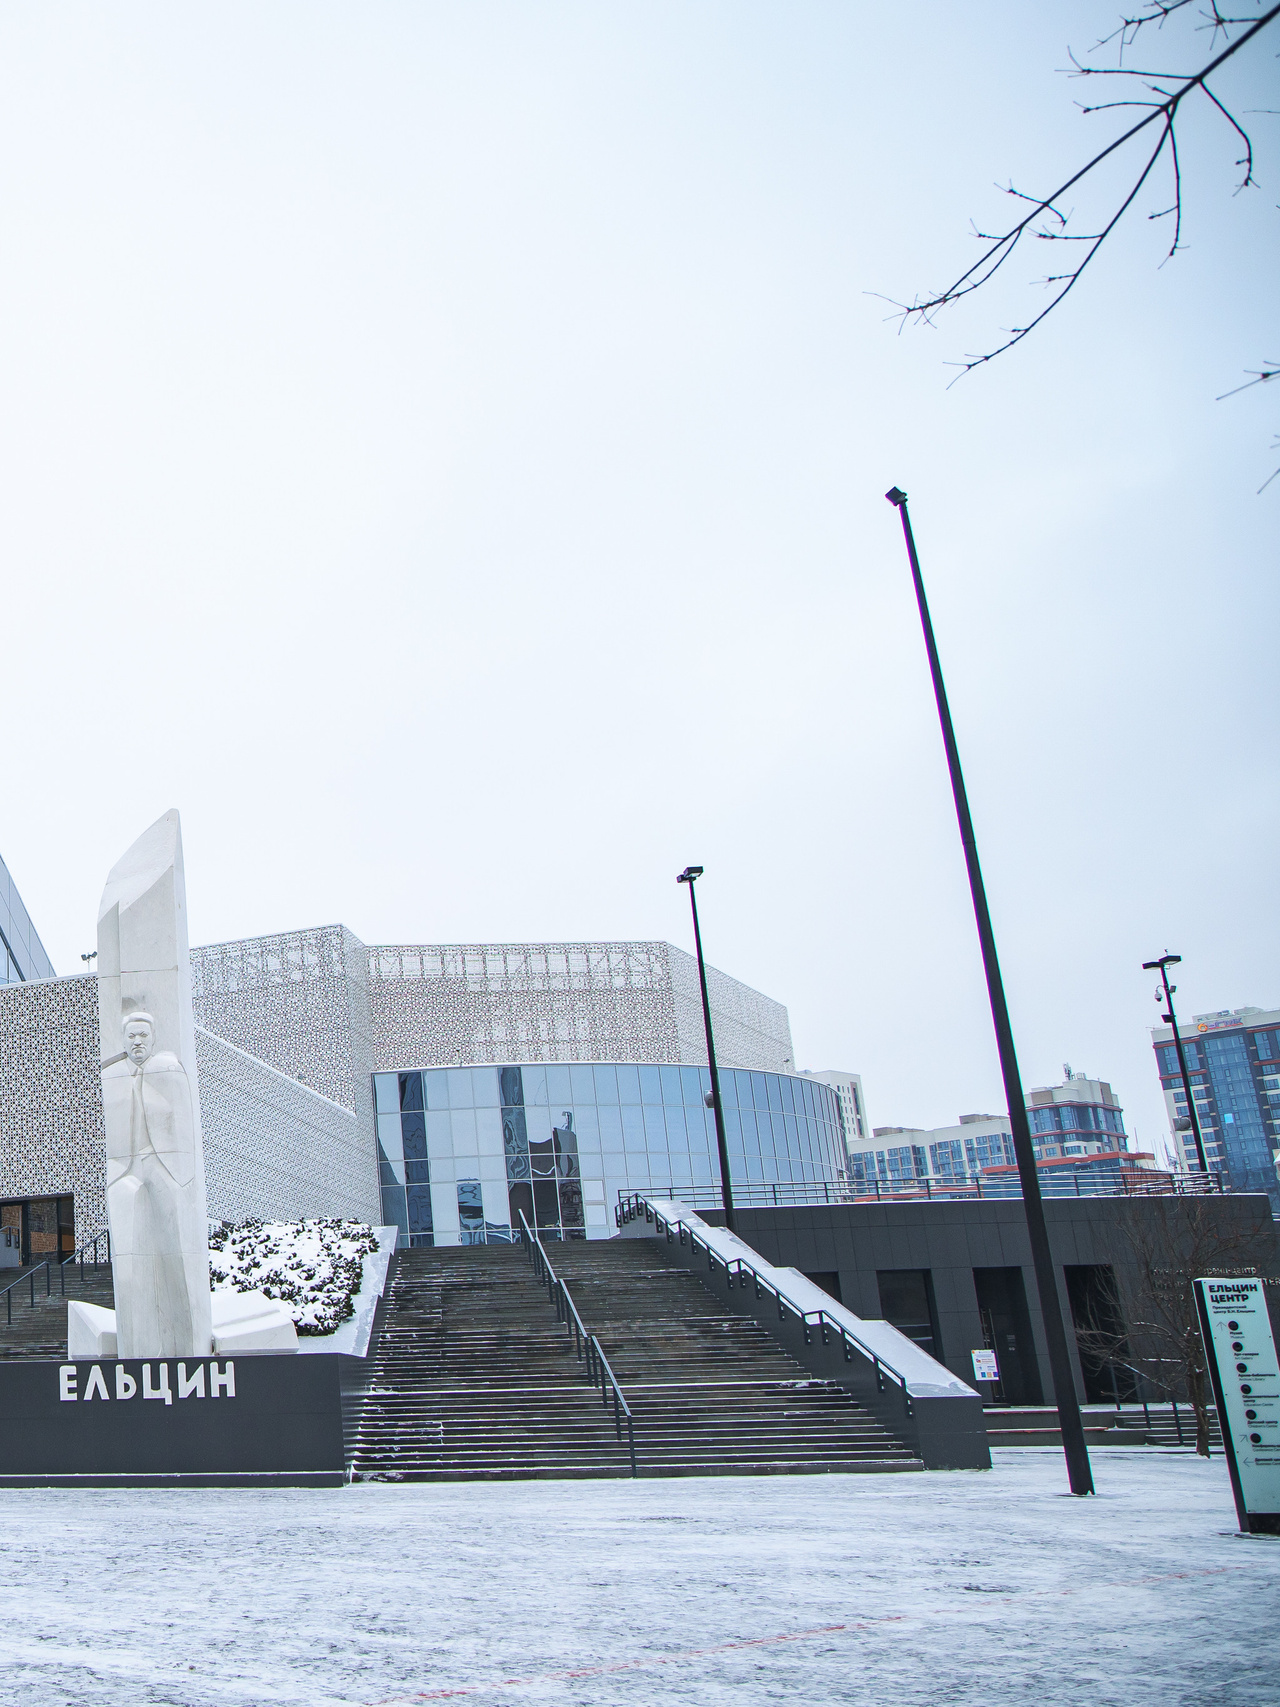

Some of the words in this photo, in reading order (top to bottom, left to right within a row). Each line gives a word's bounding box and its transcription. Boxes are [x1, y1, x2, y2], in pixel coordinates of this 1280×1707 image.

[1208, 1284, 1258, 1293] ЕЛЬЦИН
[1210, 1294, 1249, 1304] ЦЕНТР
[59, 1361, 236, 1405] ЕЛЬЦИН
